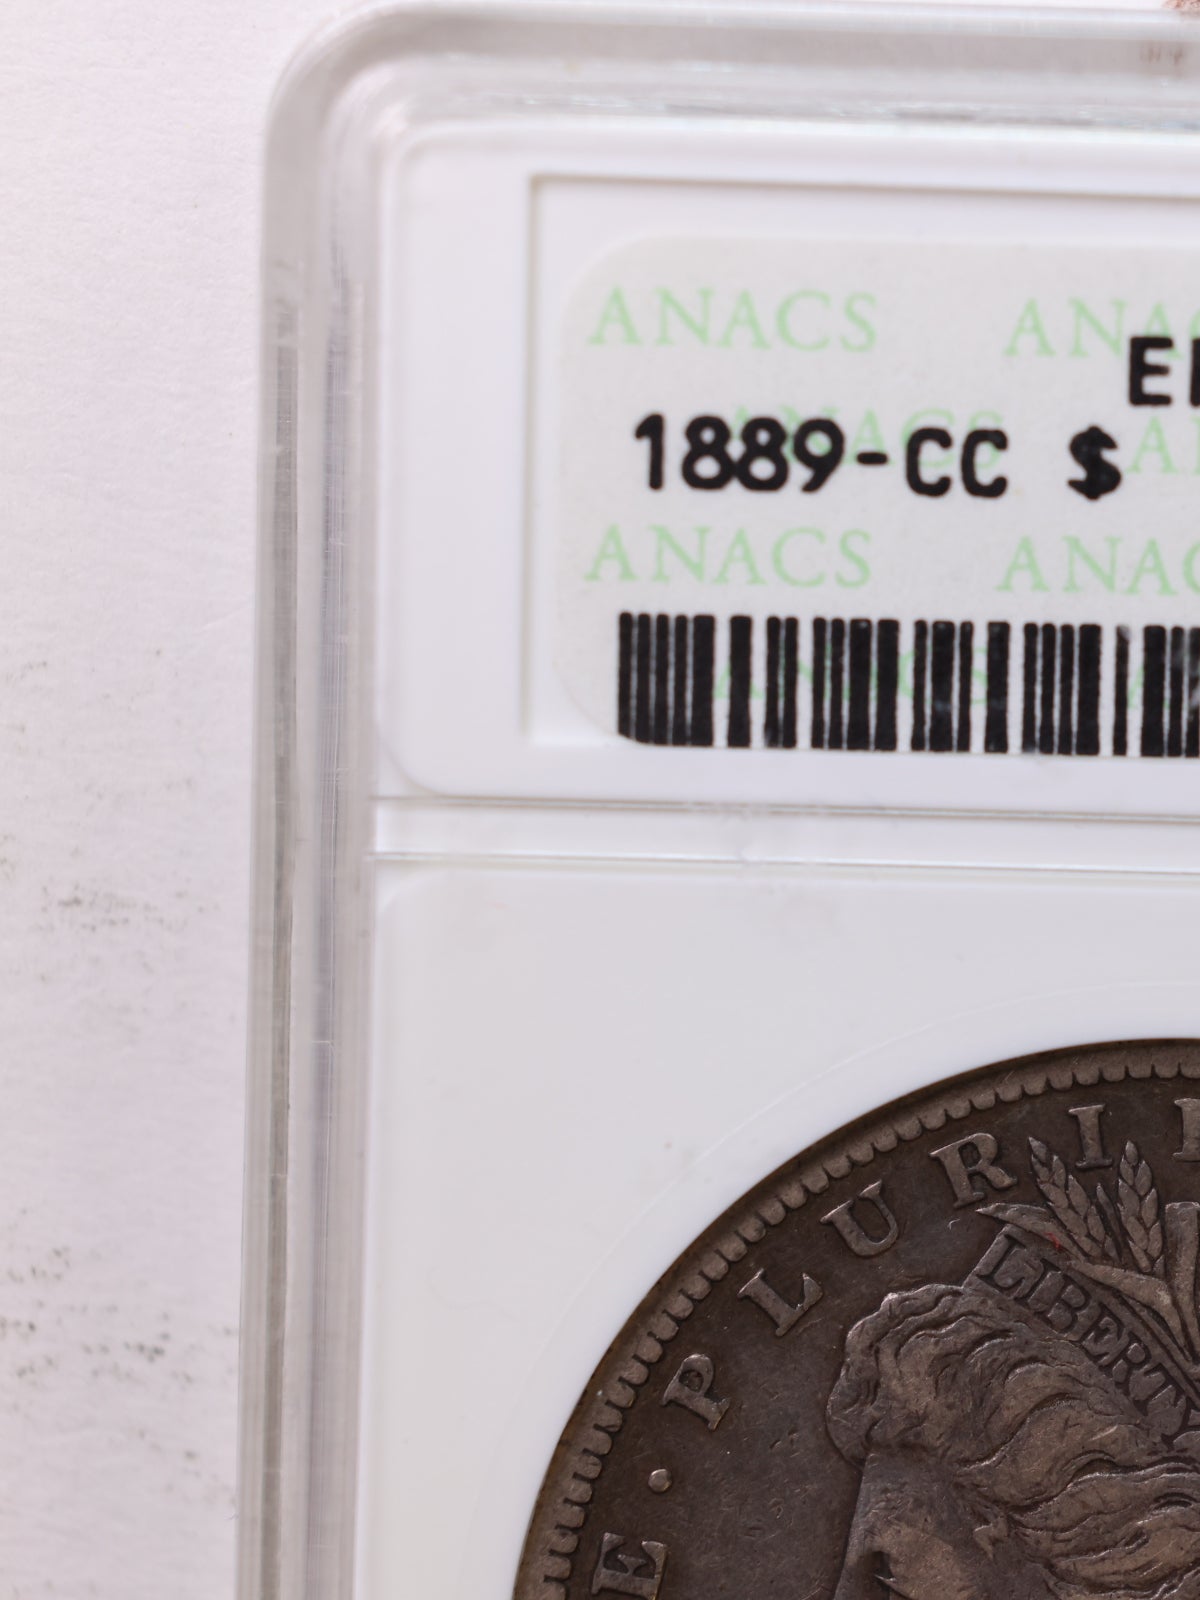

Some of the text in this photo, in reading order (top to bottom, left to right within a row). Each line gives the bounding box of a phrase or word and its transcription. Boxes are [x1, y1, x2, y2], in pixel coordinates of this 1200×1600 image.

[589, 287, 877, 353] ANACS
[634, 413, 1008, 499] 1889-CC
[1067, 425, 1122, 501] $
[584, 524, 872, 589] ANACS
[591, 1532, 668, 1600] E
